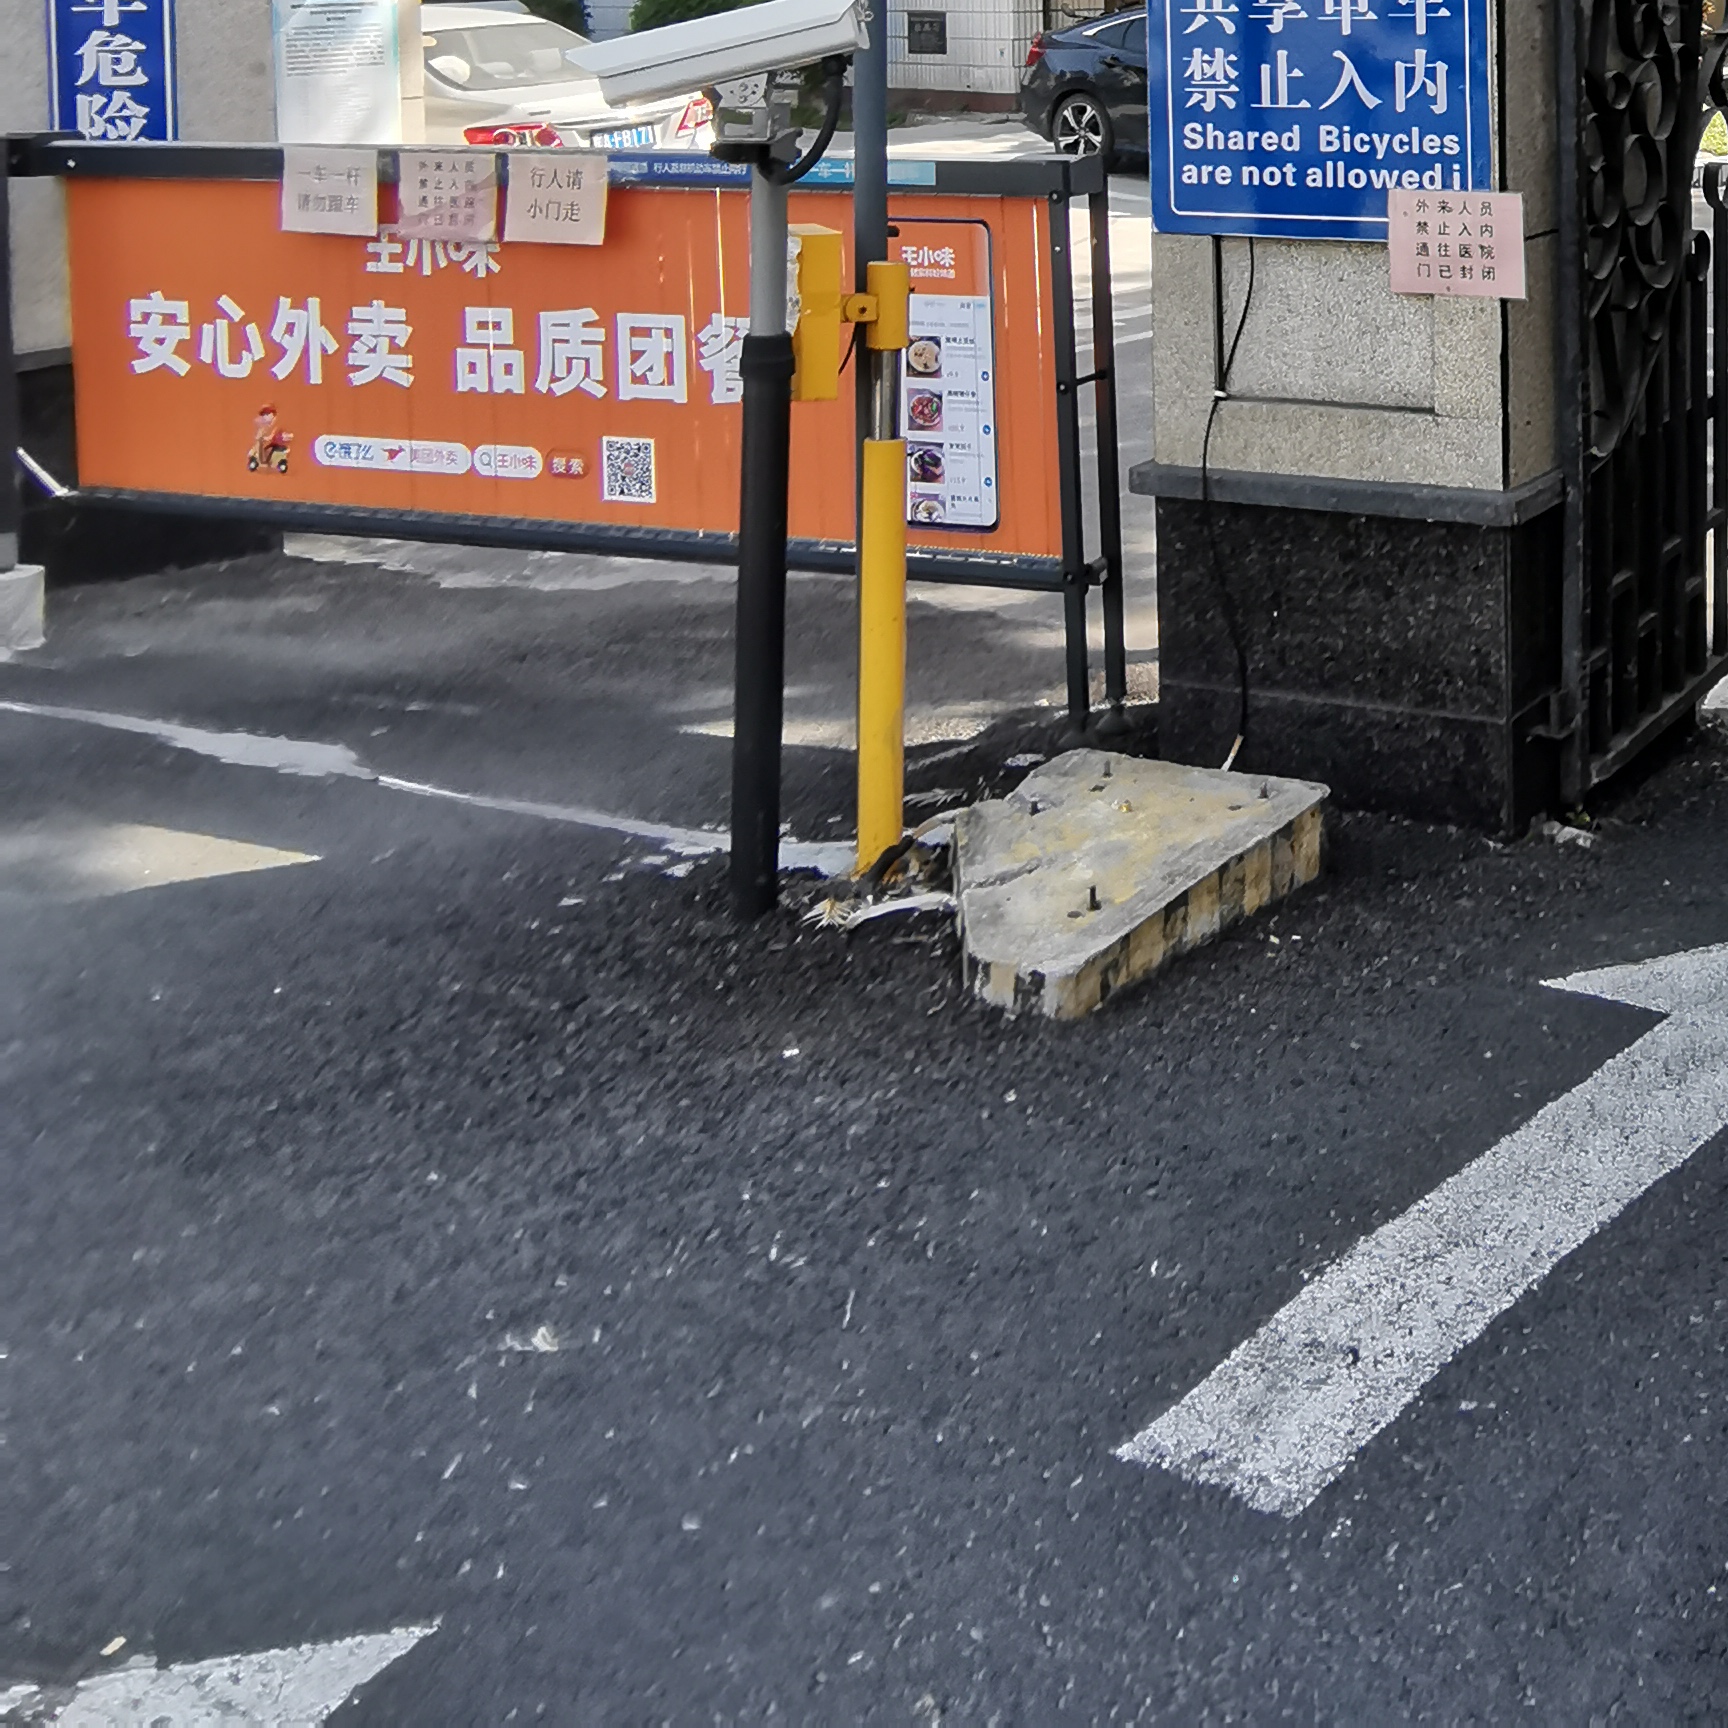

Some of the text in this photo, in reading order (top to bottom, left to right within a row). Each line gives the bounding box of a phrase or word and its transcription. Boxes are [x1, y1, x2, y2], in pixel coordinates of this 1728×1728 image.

[1183, 47, 1448, 114] 禁止入内
[1183, 123, 1461, 159] Shared Bicycles
[297, 164, 362, 187] 一车一杆
[530, 167, 584, 191] 行人请
[1181, 162, 1232, 185] are
[1241, 162, 1298, 188] not
[1305, 161, 1443, 191] allowed
[527, 200, 581, 223] 小门走
[1415, 198, 1494, 217] 外来人员
[1415, 221, 1494, 238] 禁止入内
[1415, 242, 1495, 260] 通往医院
[1416, 263, 1496, 281] 门已封闭
[129, 290, 415, 388] 安心外卖
[496, 454, 537, 471] 王小味
